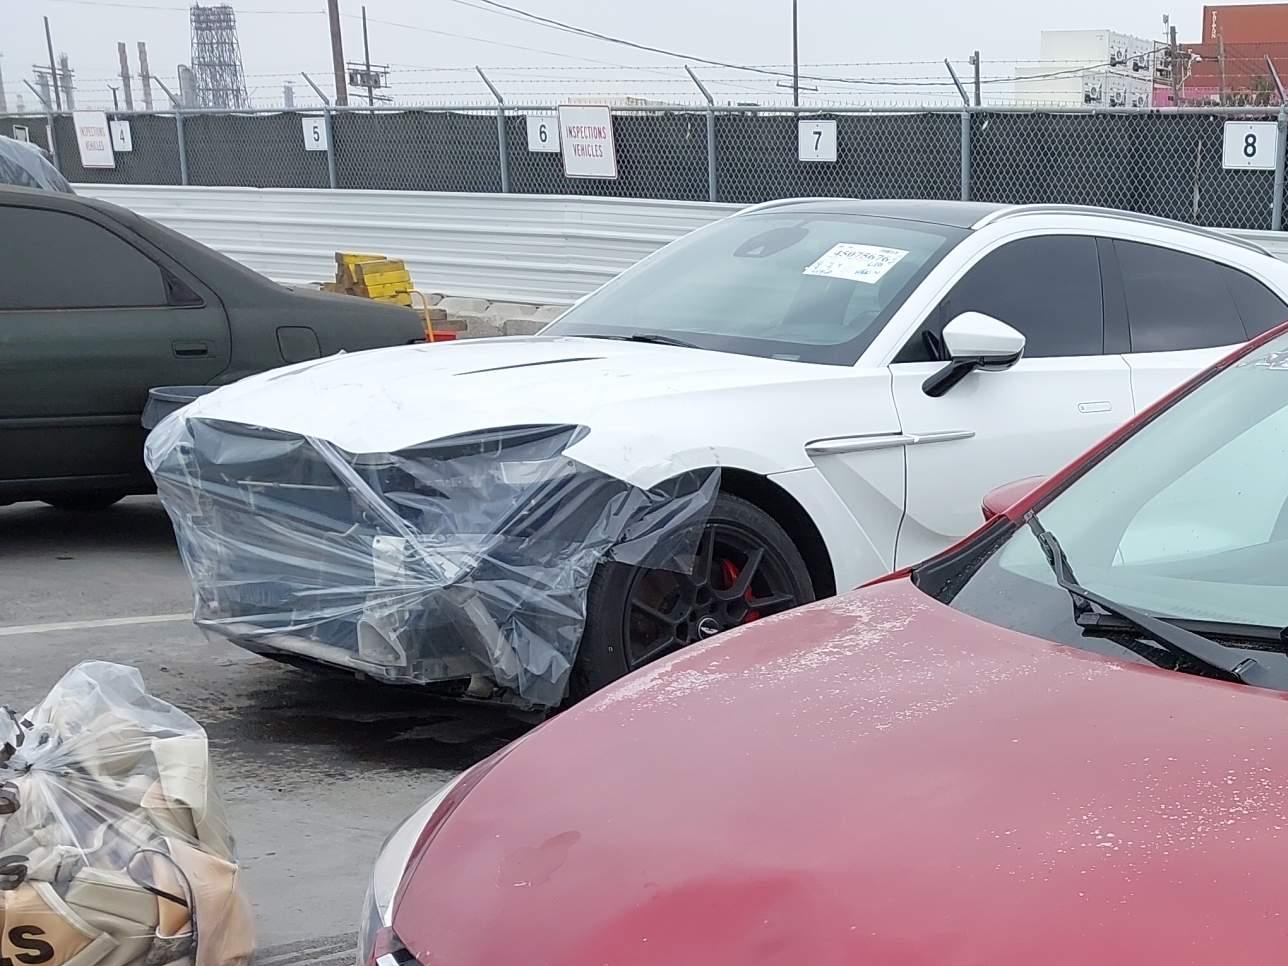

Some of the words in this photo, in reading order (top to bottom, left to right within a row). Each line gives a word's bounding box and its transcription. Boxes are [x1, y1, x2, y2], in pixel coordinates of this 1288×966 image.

[120, 128, 125, 143] 4
[312, 125, 320, 142] 5
[539, 124, 548, 142] 6
[566, 125, 607, 140] INSPECTIONS
[812, 130, 822, 151] 7
[572, 143, 603, 158] VEHICLES
[1244, 133, 1257, 158] 8
